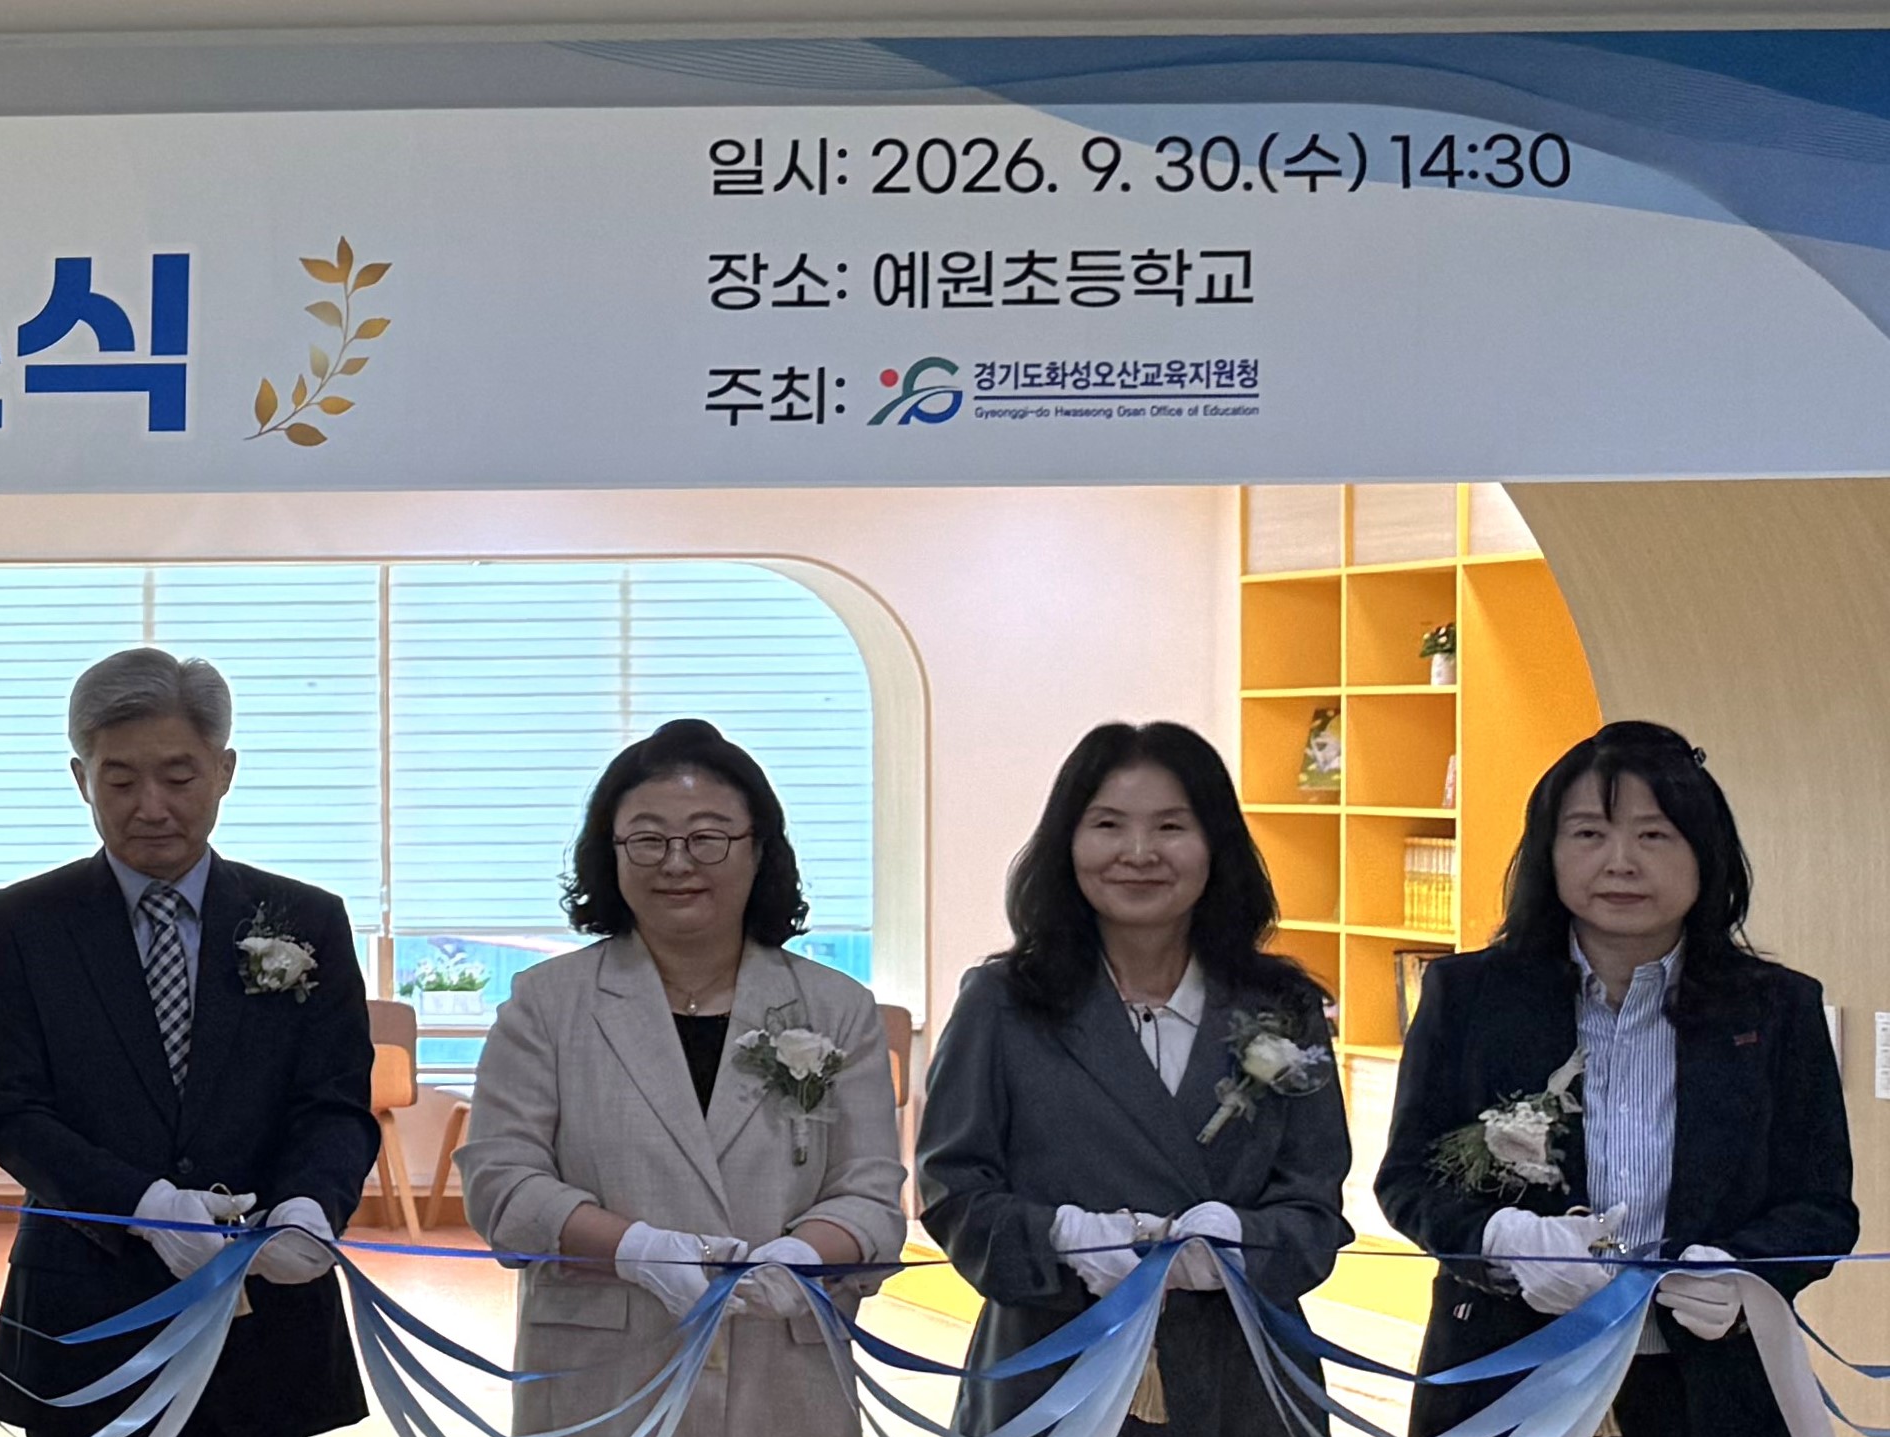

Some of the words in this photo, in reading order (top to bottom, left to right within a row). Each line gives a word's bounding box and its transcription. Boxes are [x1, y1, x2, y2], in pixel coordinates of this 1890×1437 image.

[709, 138, 848, 196] 일시:
[871, 138, 1058, 195] 2026.
[1081, 136, 1131, 193] 9.
[1155, 131, 1368, 194] 30.(수)
[1389, 131, 1572, 190] 14:30
[707, 252, 848, 311] 장소:
[873, 248, 1255, 309] 예원초등학교
[705, 366, 846, 427] 주최:
[973, 358, 1259, 391] 경기도화성오산교육지원청
[974, 405, 1051, 420] Gyeonggi-do
[1054, 405, 1114, 419] Hwaseong
[1117, 405, 1147, 418] Osan
[1150, 404, 1184, 418] Office
[1187, 404, 1199, 417] of
[1202, 404, 1260, 417] Education
